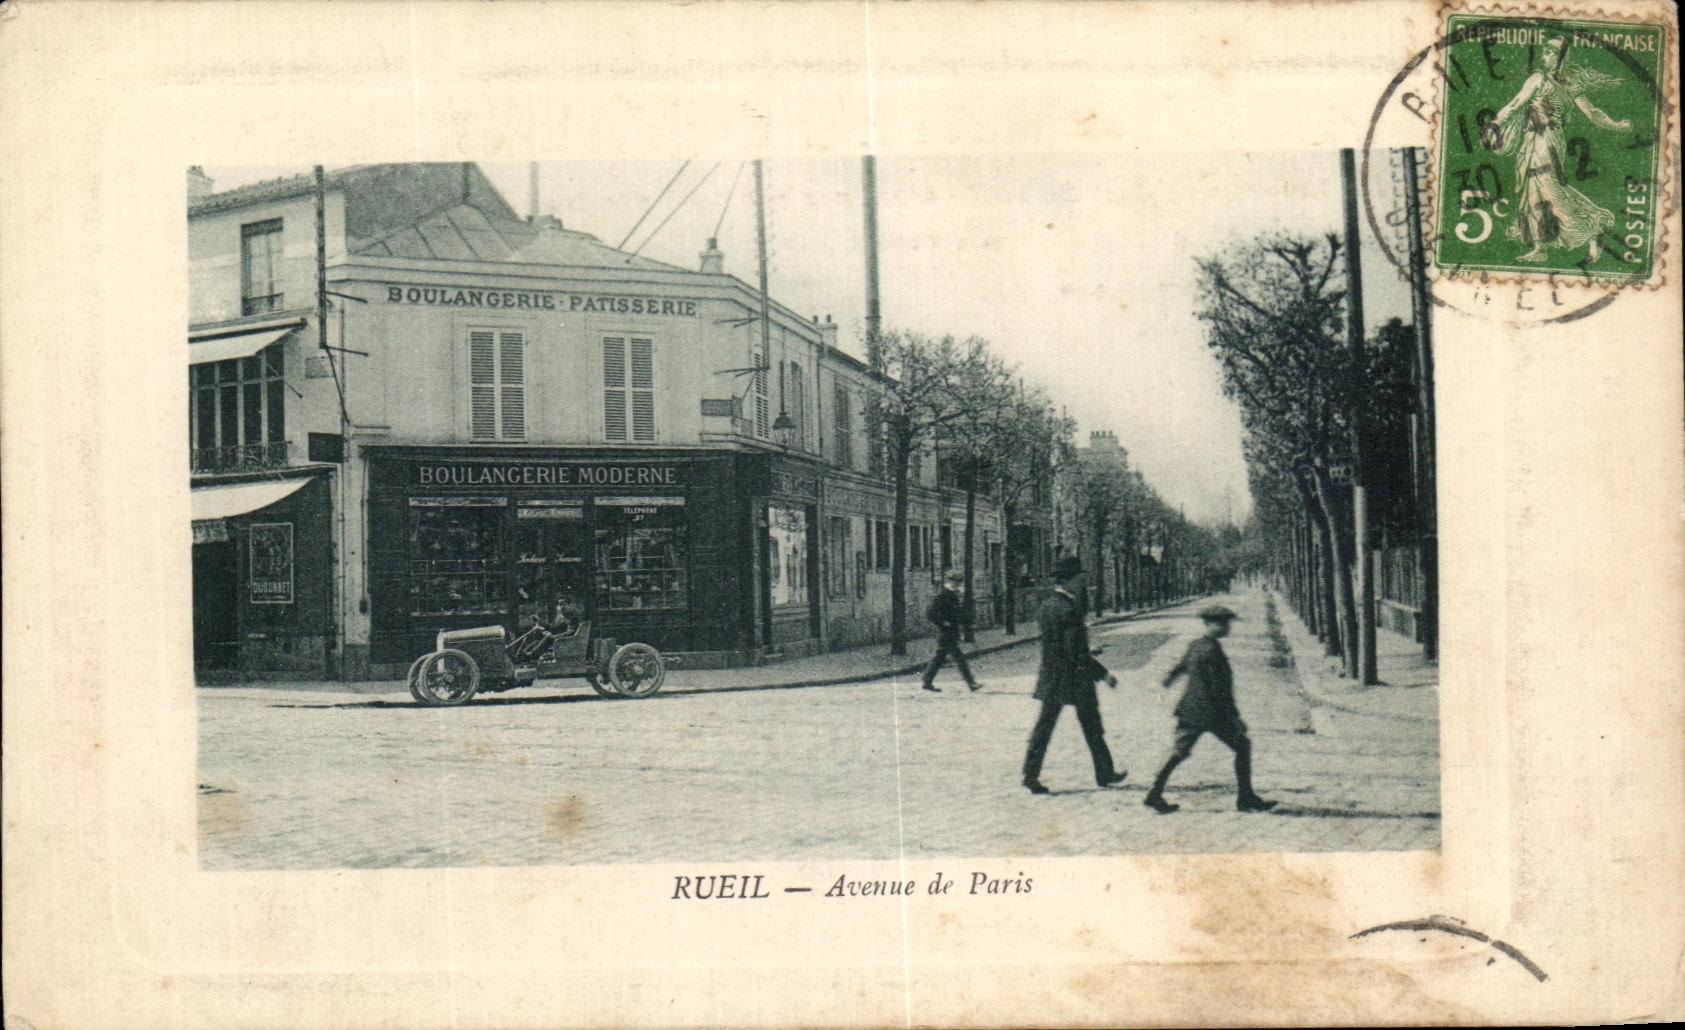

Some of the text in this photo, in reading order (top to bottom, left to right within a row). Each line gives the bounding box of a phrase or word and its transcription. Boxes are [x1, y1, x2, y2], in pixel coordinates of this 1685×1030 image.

[1623, 182, 1648, 264] POSTES
[387, 285, 698, 317] BOULANGERIE PATISSERIE
[419, 466, 677, 484] BOULANGERIE MODERNE
